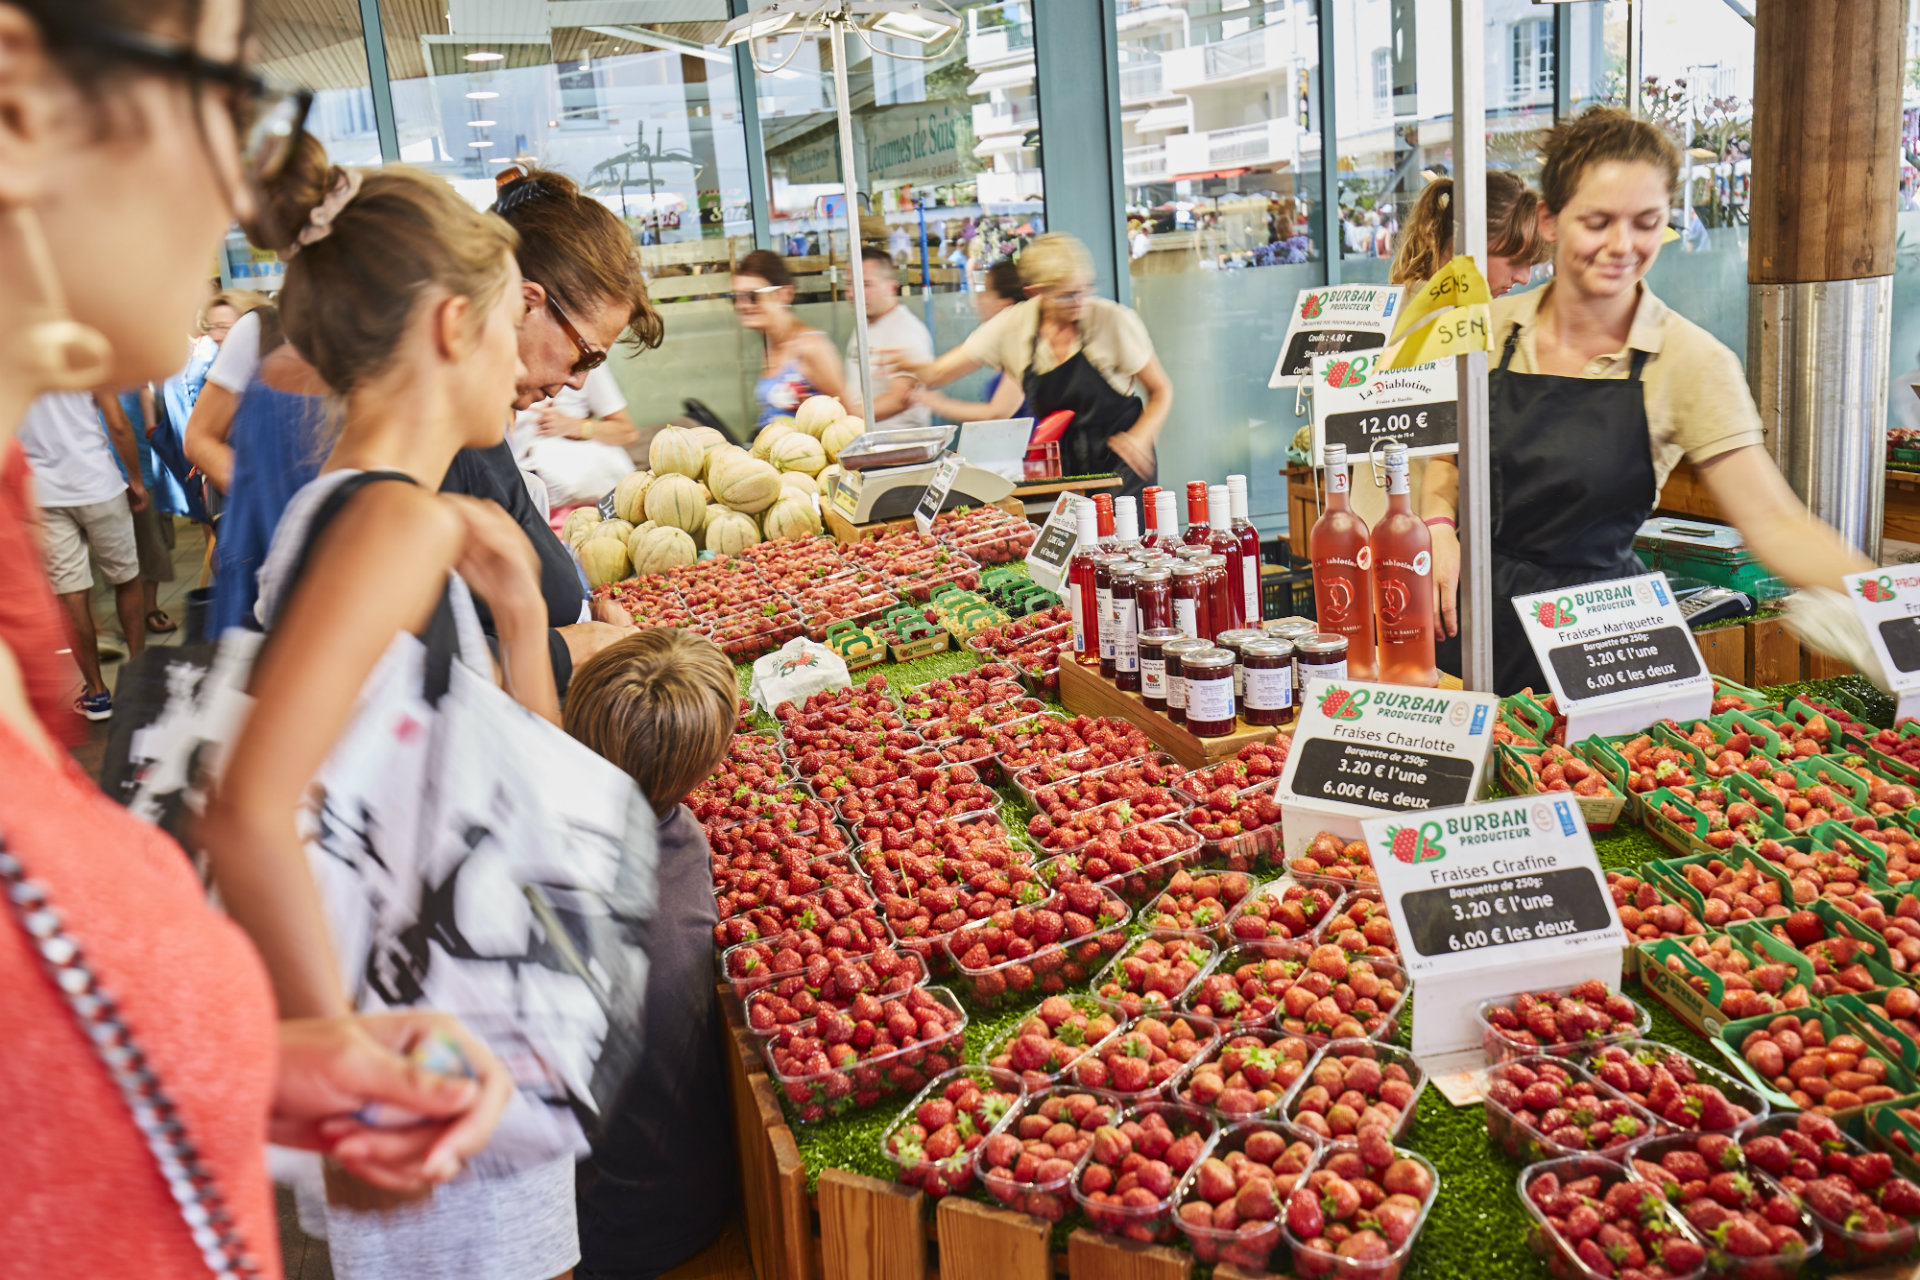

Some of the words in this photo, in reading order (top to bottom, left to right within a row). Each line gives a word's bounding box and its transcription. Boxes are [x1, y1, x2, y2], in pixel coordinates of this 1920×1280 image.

[914, 117, 926, 160] de
[1329, 290, 1377, 302] BURBAN
[1429, 274, 1469, 301] SENS
[1330, 303, 1370, 311] PRODUCTEUR
[1347, 335, 1353, 343] €
[1359, 389, 1373, 401] La
[1373, 379, 1432, 396] Diablotine
[1359, 414, 1411, 435] 12.00
[1415, 411, 1428, 428] €
[1575, 585, 1633, 606] BURBAN
[1586, 599, 1636, 614] PRODUCTEUR
[1559, 628, 1601, 642] Fraises
[1604, 615, 1664, 632] Mariguette
[1583, 640, 1619, 651] Barquette
[1620, 637, 1629, 645] de
[1585, 651, 1615, 668] 3.20
[1616, 649, 1627, 661] €
[1626, 645, 1658, 660] l'une
[1586, 673, 1615, 689] 6.00
[1616, 670, 1626, 683] €
[1626, 669, 1646, 681] les
[1646, 663, 1677, 678] deux
[1373, 691, 1450, 714] BURBAN
[1377, 707, 1443, 725] PRODUCTEUR
[1333, 724, 1381, 741] Fraises
[1386, 731, 1456, 752] Charlotte
[1344, 745, 1389, 760] Barquette
[1389, 752, 1402, 761] de
[1338, 758, 1371, 776] 3.20
[1374, 764, 1386, 778] €
[1388, 766, 1428, 784] l'une
[1323, 780, 1366, 799] 6.00€
[1368, 786, 1390, 803] les
[1392, 791, 1430, 809] deux
[1445, 808, 1527, 835] BURBAN
[1459, 827, 1531, 846] PRODUCTEUR
[1430, 865, 1489, 884] Fraises
[1492, 855, 1557, 875] Cirafine
[1449, 883, 1499, 900] Barquette
[1500, 880, 1514, 891] de
[1451, 900, 1491, 921] 3.20
[1494, 897, 1508, 914] €
[1508, 893, 1554, 912] l'une
[1448, 929, 1489, 951] 6.00
[1491, 927, 1504, 944] €
[1505, 925, 1532, 943] les
[1534, 919, 1578, 938] deux
